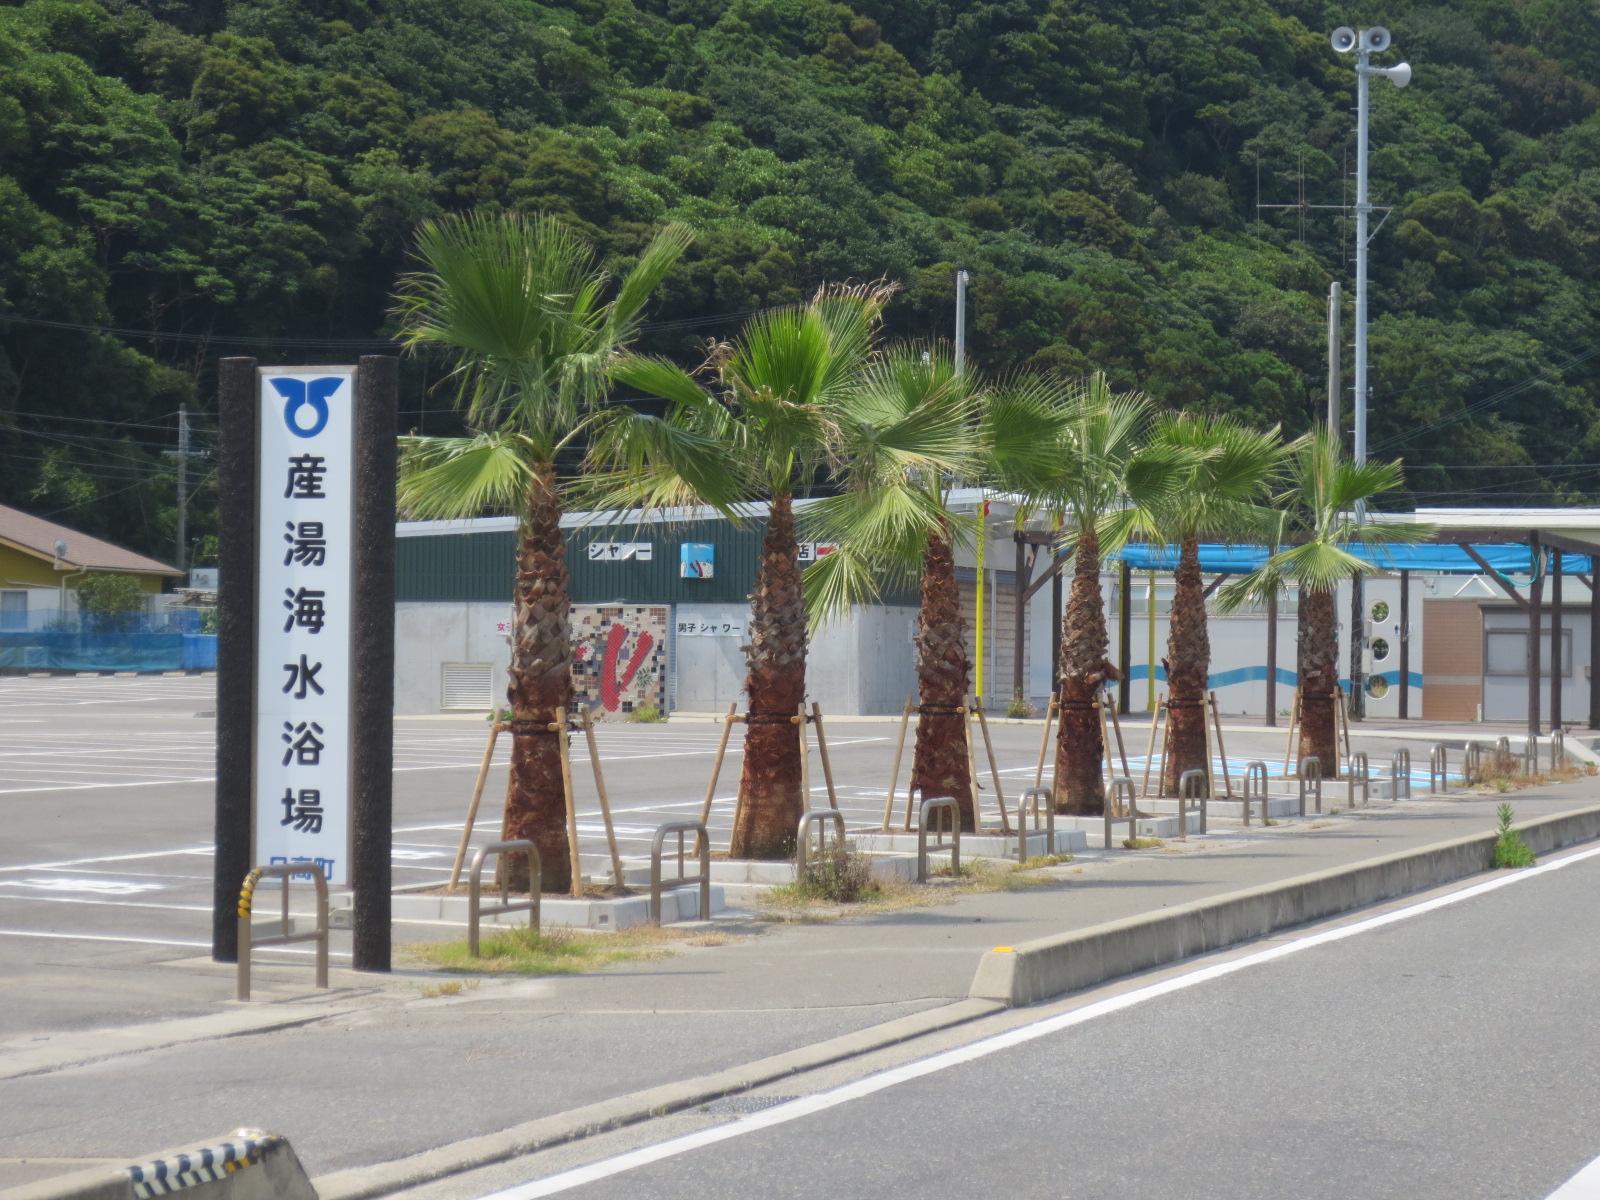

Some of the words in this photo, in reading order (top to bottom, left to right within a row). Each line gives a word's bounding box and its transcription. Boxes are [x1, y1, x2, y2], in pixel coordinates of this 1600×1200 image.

[280, 452, 327, 834] 産湯海水浴場
[590, 543, 651, 559] シャー
